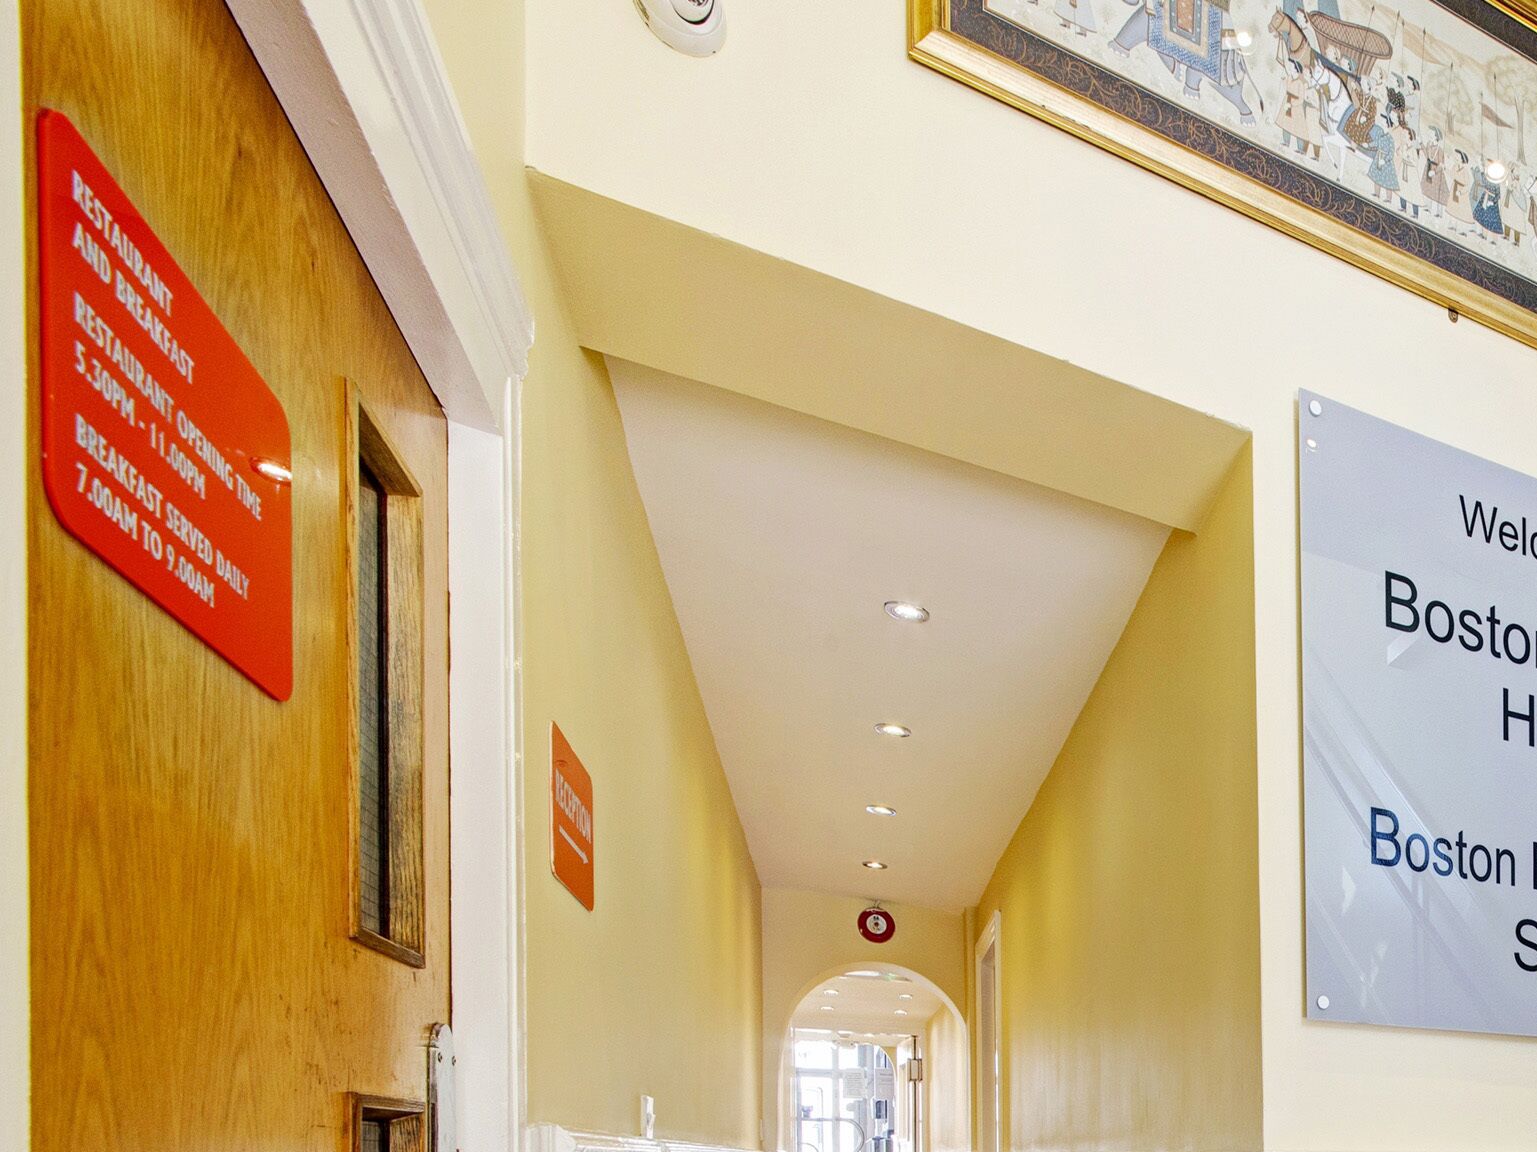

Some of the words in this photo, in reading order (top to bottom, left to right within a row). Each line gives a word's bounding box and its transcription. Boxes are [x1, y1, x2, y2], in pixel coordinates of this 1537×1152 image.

[72, 169, 173, 317] RESTAURANT
[72, 222, 112, 285] AND
[115, 268, 195, 385] BREAKFAST
[74, 290, 174, 423] RESTAURANT
[176, 410, 234, 491] OPENING
[235, 474, 262, 522] TIME
[74, 340, 136, 427] 5.30PM
[150, 422, 206, 500] 11.00PM
[75, 413, 163, 519] BREAKFAST
[166, 502, 214, 566] SERVED
[216, 549, 250, 601] DAILY
[76, 462, 138, 541] 7.00AM
[141, 520, 163, 561] TO
[166, 544, 215, 609] 9.00AM
[1370, 807, 1516, 887] Boston
